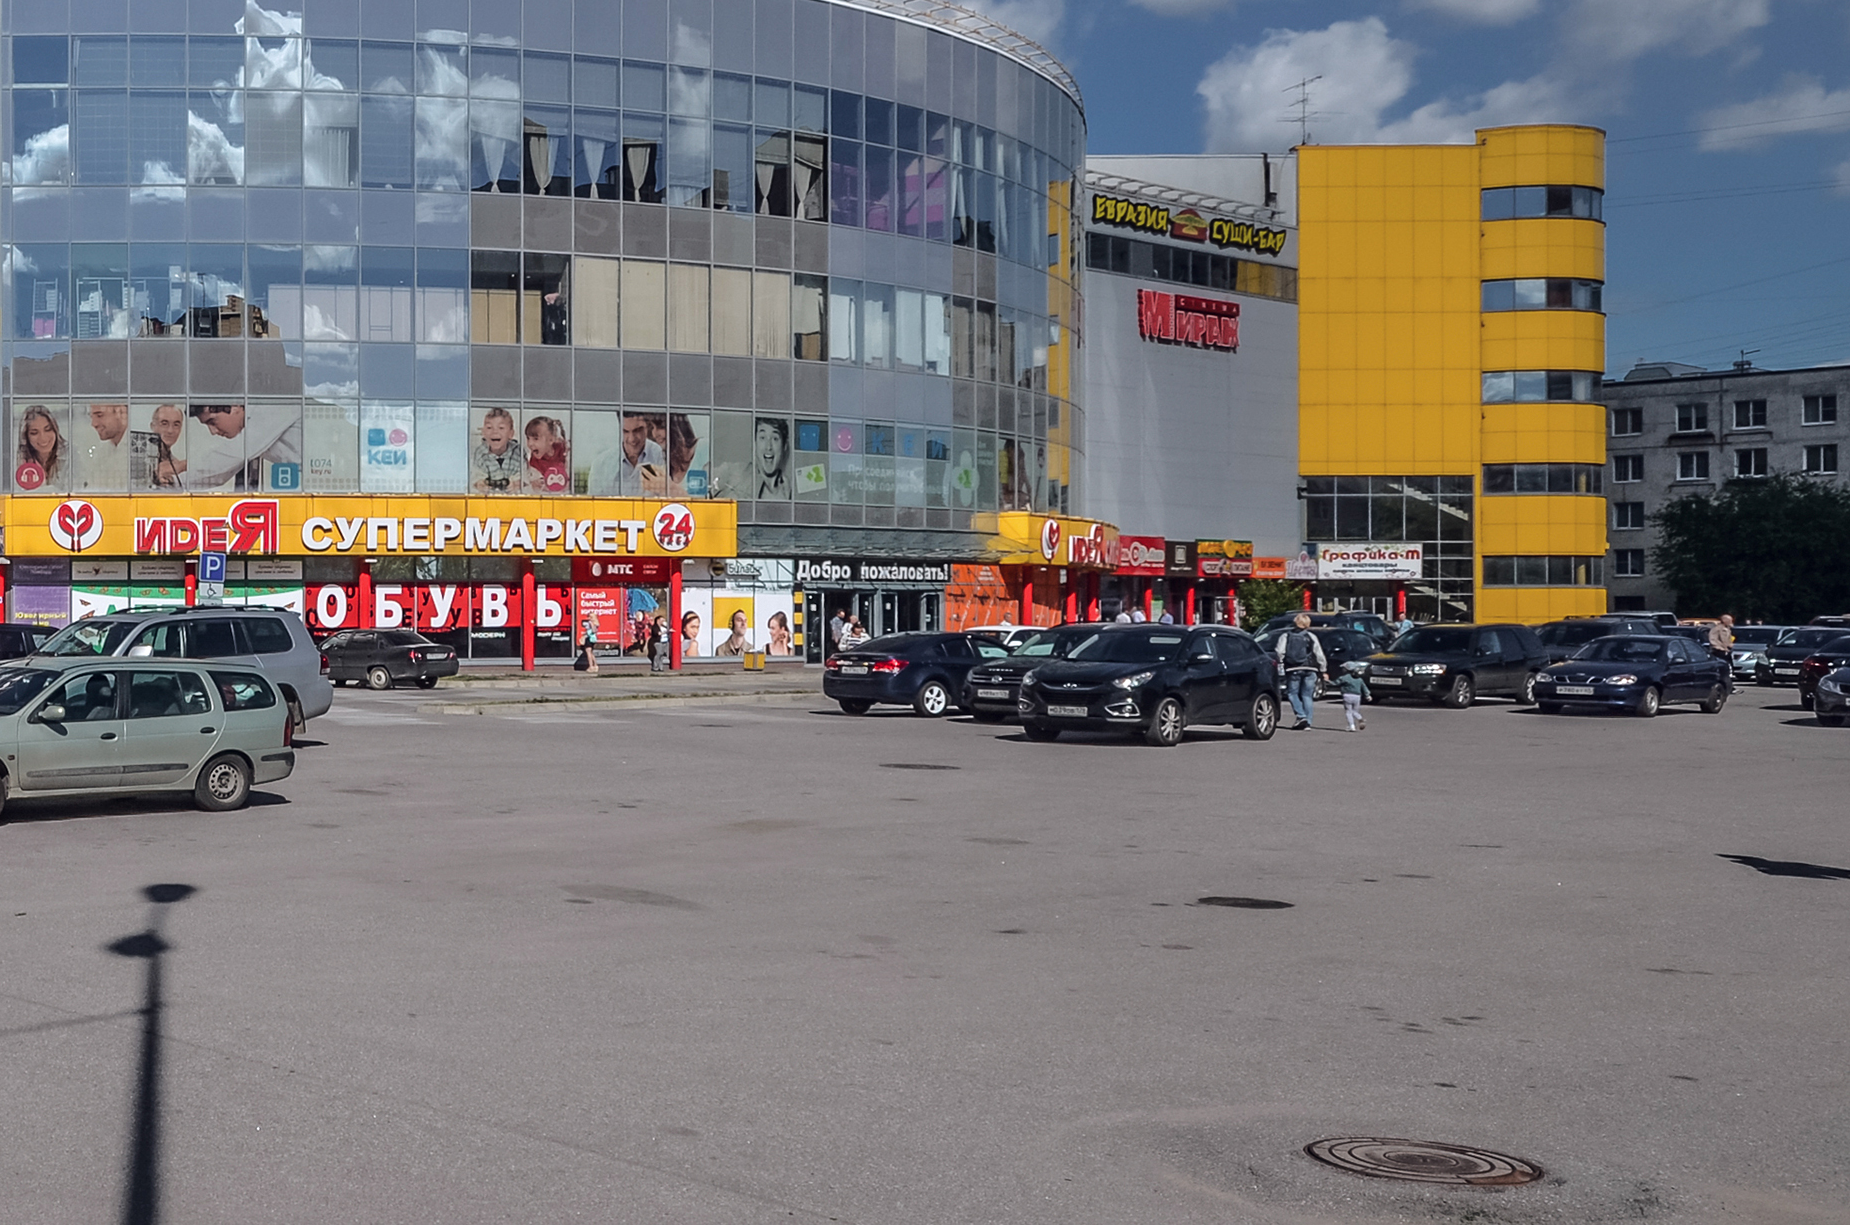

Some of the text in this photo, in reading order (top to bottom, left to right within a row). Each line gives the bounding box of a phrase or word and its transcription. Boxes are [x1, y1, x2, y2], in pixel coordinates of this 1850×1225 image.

[1095, 196, 1286, 252] ЕВРАЗИЯ СУШИ-БАР
[302, 516, 646, 551] СУПЕРМАРКЕТ
[659, 513, 692, 534] 24
[608, 564, 633, 574] МТС
[797, 560, 949, 582] Добро пожаловать!
[581, 591, 606, 599] Самый
[581, 600, 615, 608] быстрый
[317, 584, 562, 628] ОБУВЬ
